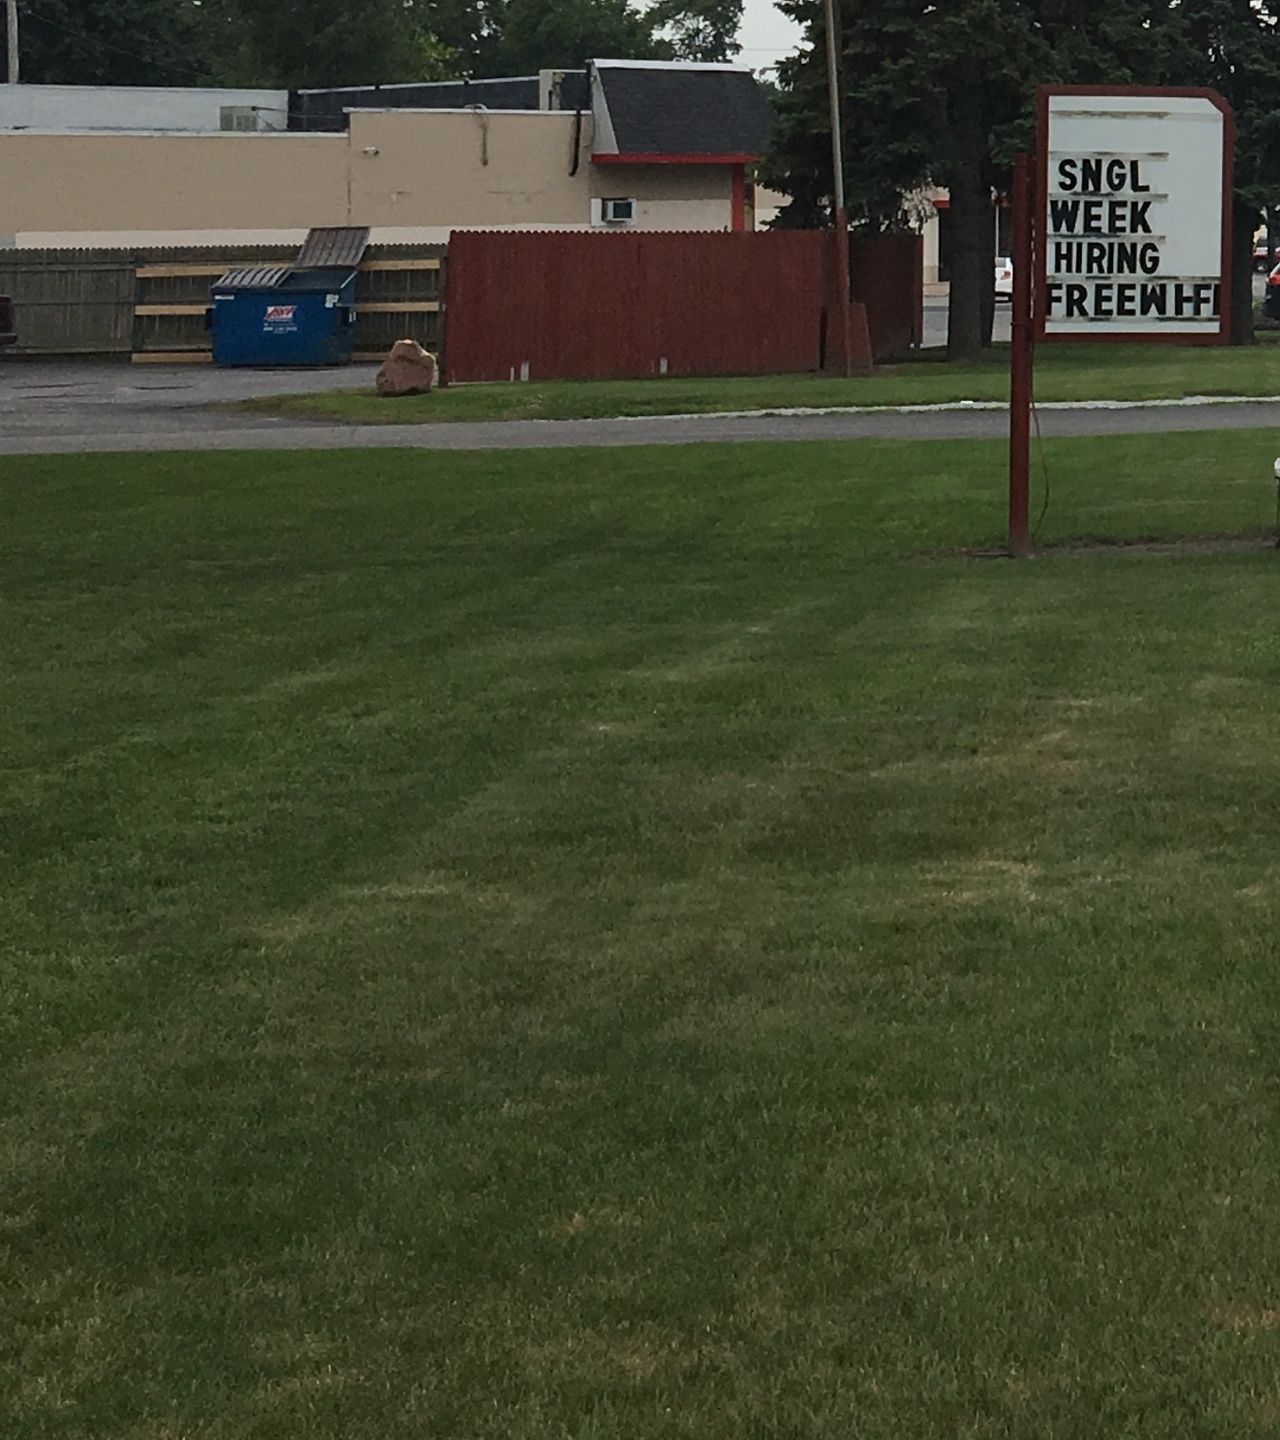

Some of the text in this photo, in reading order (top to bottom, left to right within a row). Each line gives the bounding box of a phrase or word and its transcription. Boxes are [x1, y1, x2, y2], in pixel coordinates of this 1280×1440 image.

[1058, 158, 1150, 192] SNGL
[1050, 200, 1152, 234] WEEK
[1054, 242, 1160, 274] HIRING
